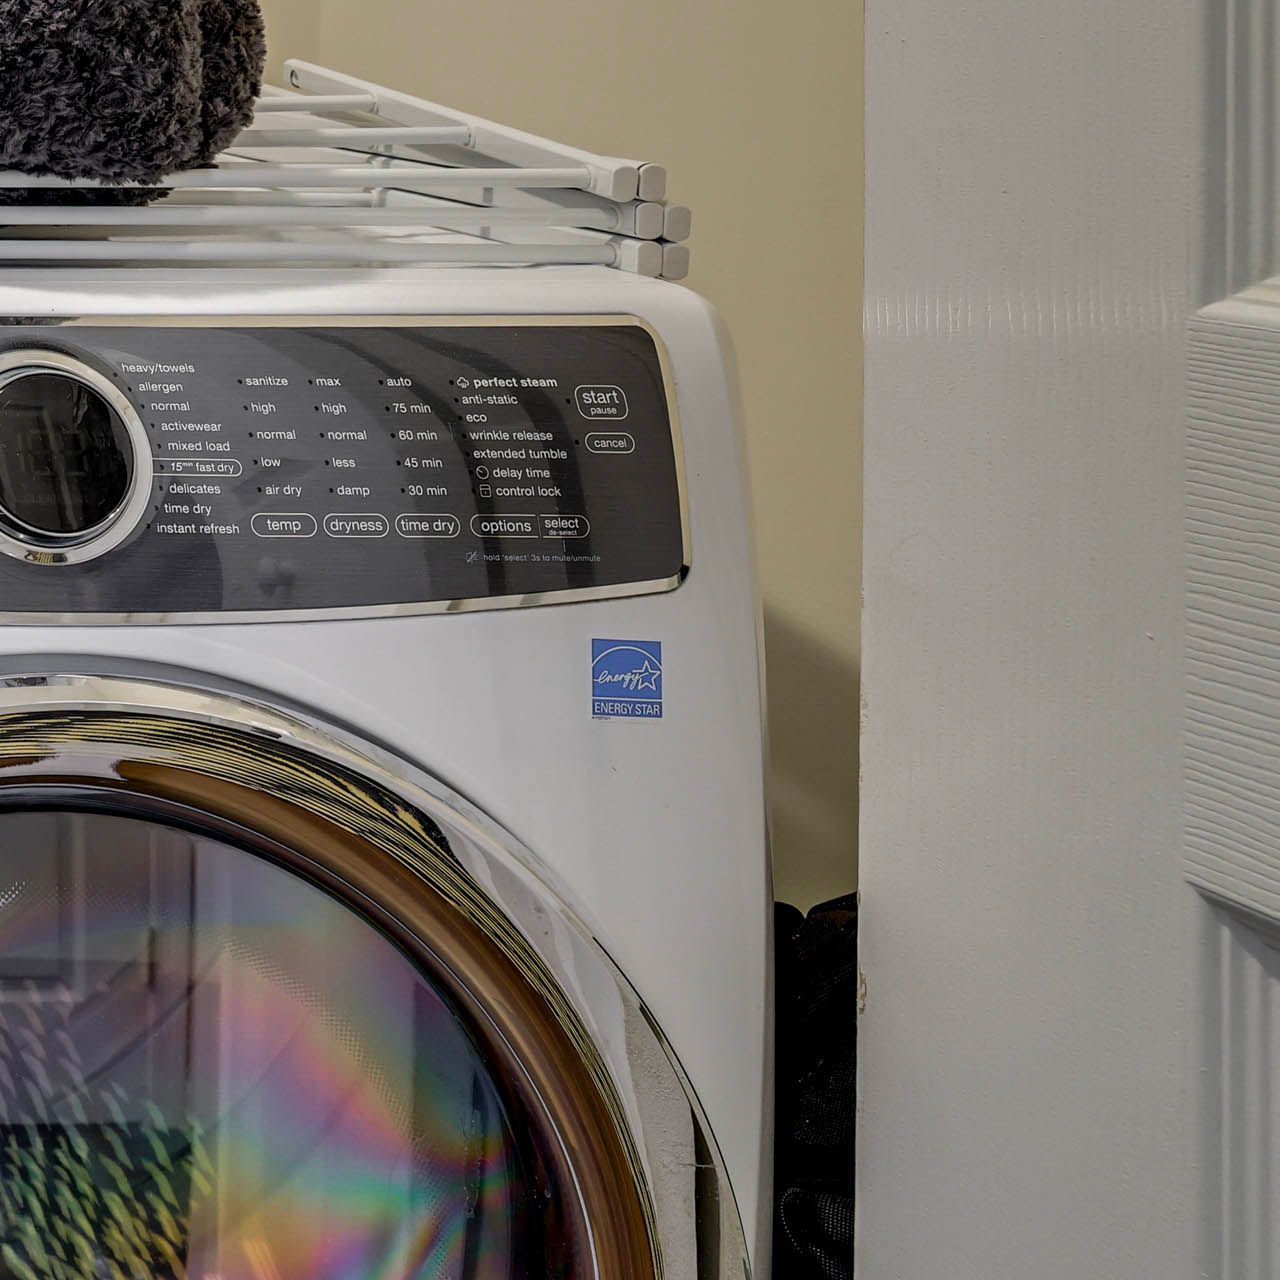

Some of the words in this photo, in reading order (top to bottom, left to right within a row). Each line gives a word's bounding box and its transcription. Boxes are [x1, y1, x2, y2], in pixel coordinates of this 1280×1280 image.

[121, 362, 195, 375] heavy/towels
[245, 375, 289, 386] sanitize
[315, 378, 341, 386] max
[386, 377, 412, 387] auto
[473, 377, 519, 389] perfect
[520, 377, 558, 387] steam
[138, 381, 184, 394] allergen
[462, 394, 518, 405] anti-static
[582, 390, 620, 404] start
[150, 401, 190, 411] normal
[250, 402, 276, 415] high
[321, 402, 347, 415] high
[392, 403, 407, 413] 75
[410, 402, 432, 413] min
[590, 407, 617, 416] pause
[466, 414, 488, 423] eco
[161, 421, 222, 432] activewear
[256, 429, 297, 440] normal
[327, 430, 367, 440] normal
[398, 430, 414, 441] 60
[416, 430, 438, 440] min
[469, 430, 510, 441] wrinkle
[512, 430, 553, 441] release
[167, 440, 203, 451] mixed
[205, 441, 231, 452] load
[593, 438, 627, 448] cancel
[473, 448, 526, 459] extended
[528, 448, 568, 459] tumble
[261, 456, 281, 467] low
[332, 457, 356, 468] less
[404, 457, 419, 468] 45
[421, 457, 443, 468] min
[195, 462, 216, 472] fast
[217, 463, 234, 475] dry
[492, 467, 523, 480] delay
[525, 467, 550, 478] time
[169, 483, 221, 495] delicates
[265, 484, 280, 495] air
[283, 484, 302, 497] dry
[336, 485, 370, 498] damp
[408, 485, 423, 496] 30
[426, 485, 448, 496] min
[495, 486, 535, 497] control
[537, 485, 562, 497] lock
[164, 503, 190, 514] time
[192, 503, 212, 517] dry
[157, 522, 196, 534] instant
[199, 522, 240, 534] refresh
[266, 519, 302, 534] temp
[330, 518, 383, 534] dryness
[400, 518, 429, 531] time
[432, 519, 455, 534] dry
[481, 519, 532, 534] options
[544, 517, 579, 529] select
[542, 554, 550, 562] to
[594, 702, 633, 714] ENERGY
[635, 704, 661, 716] STAR
